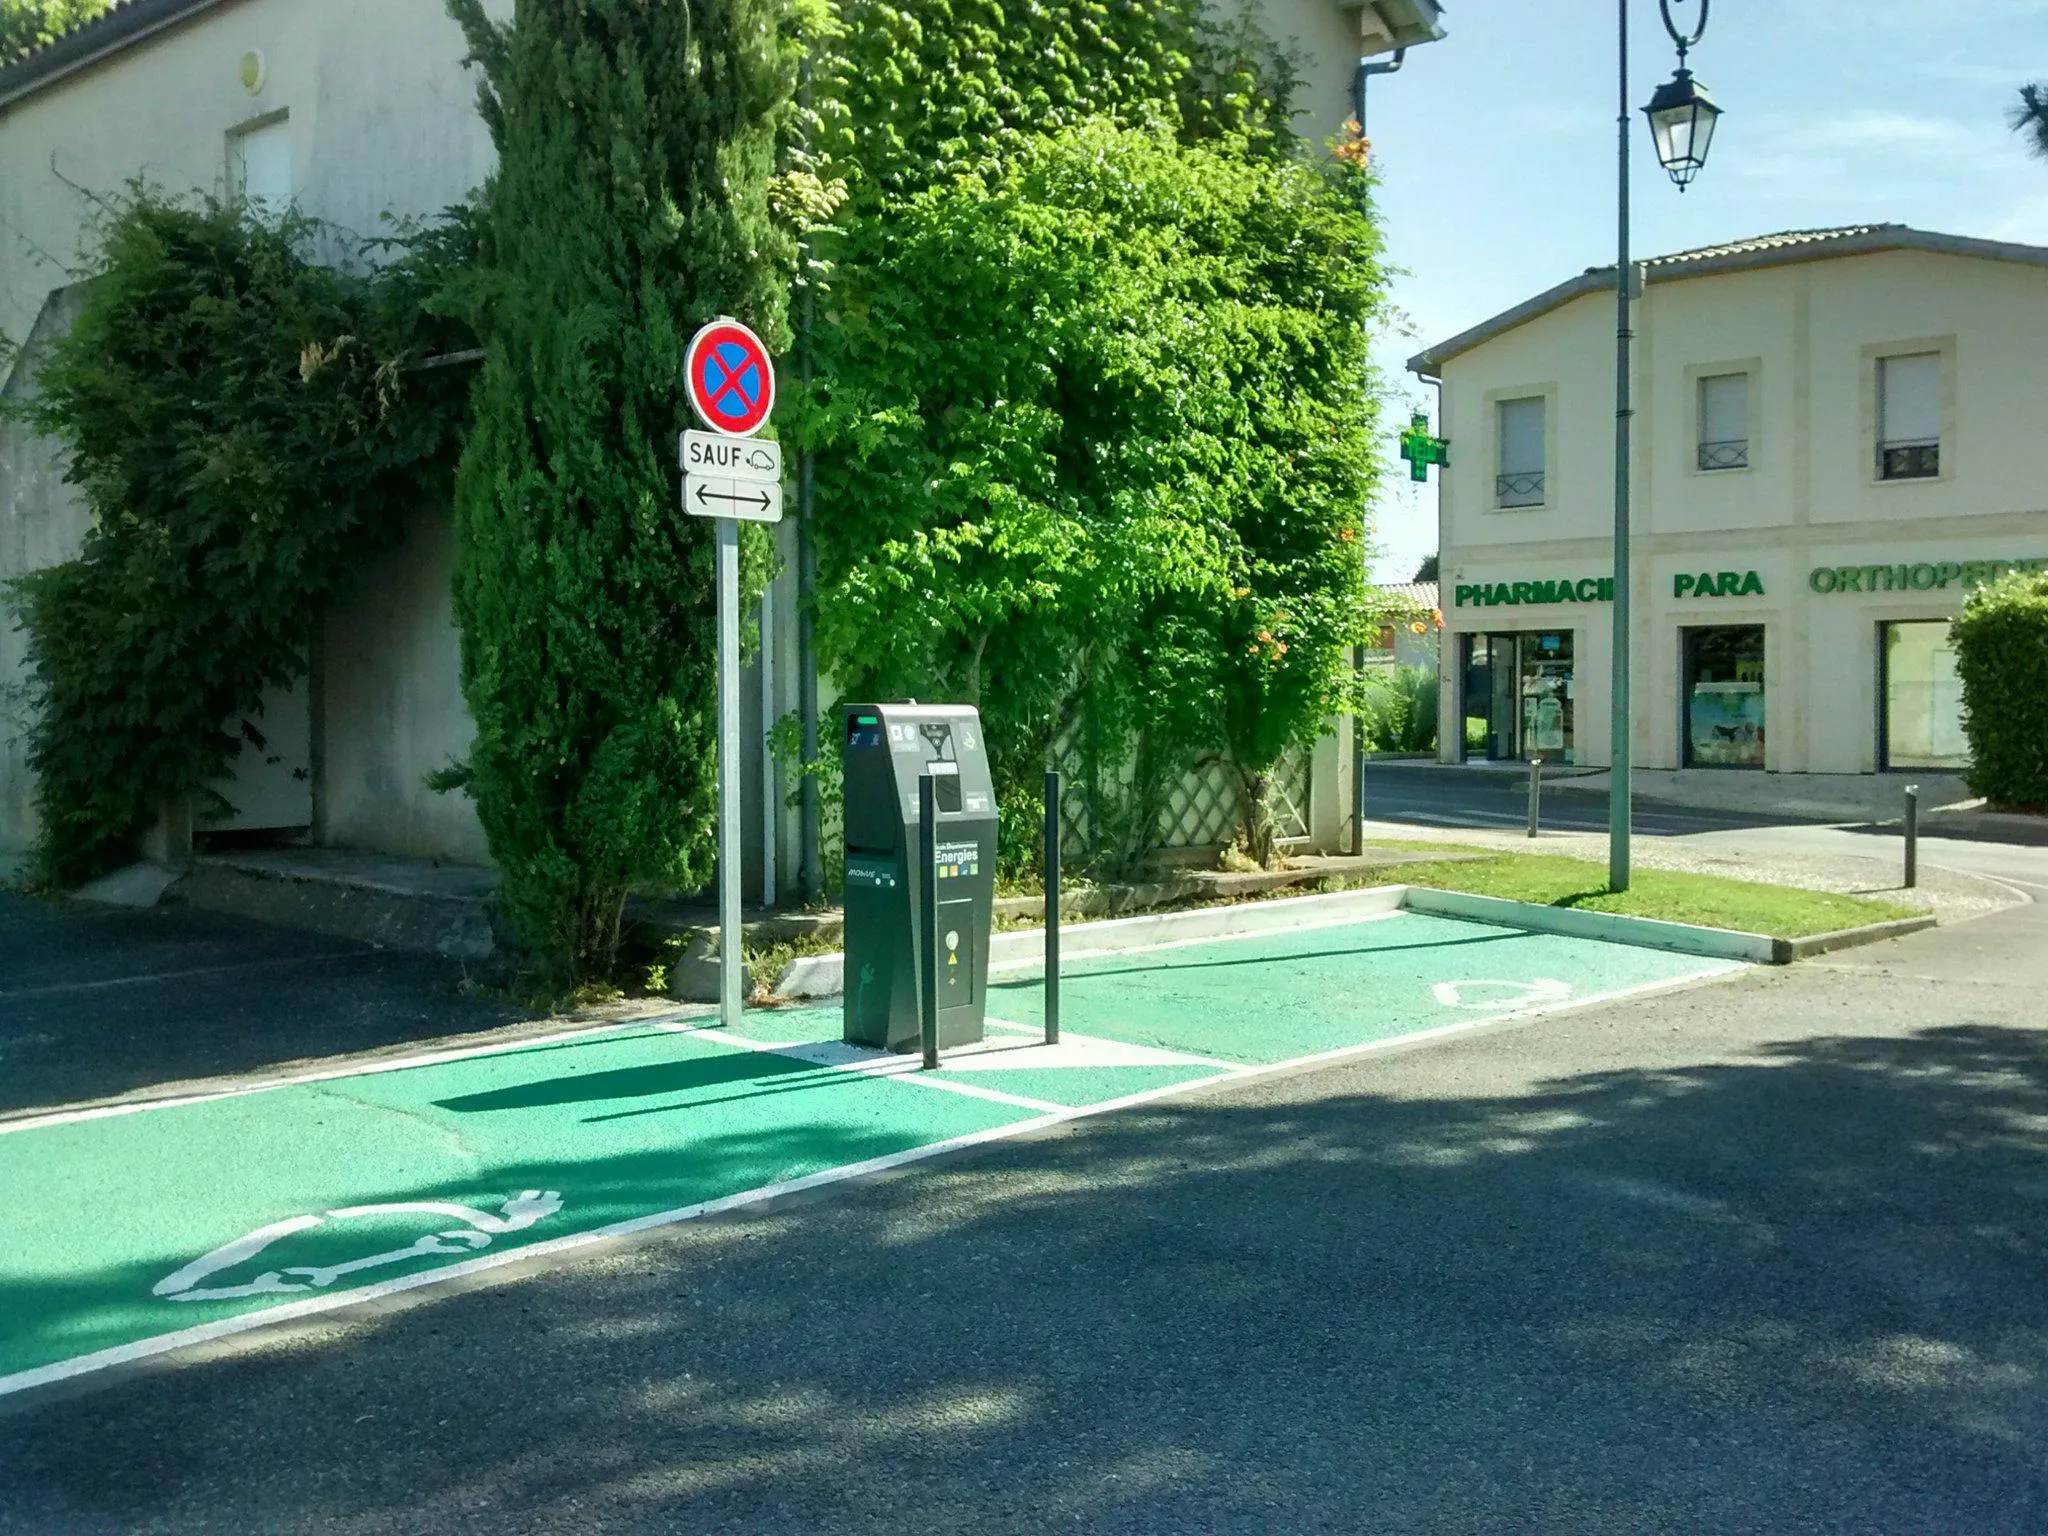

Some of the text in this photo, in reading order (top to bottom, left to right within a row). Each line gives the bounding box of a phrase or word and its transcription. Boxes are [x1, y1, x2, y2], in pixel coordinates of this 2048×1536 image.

[690, 442, 741, 467] SAUF
[1673, 570, 1765, 598] PARA
[936, 849, 978, 865] Energies
